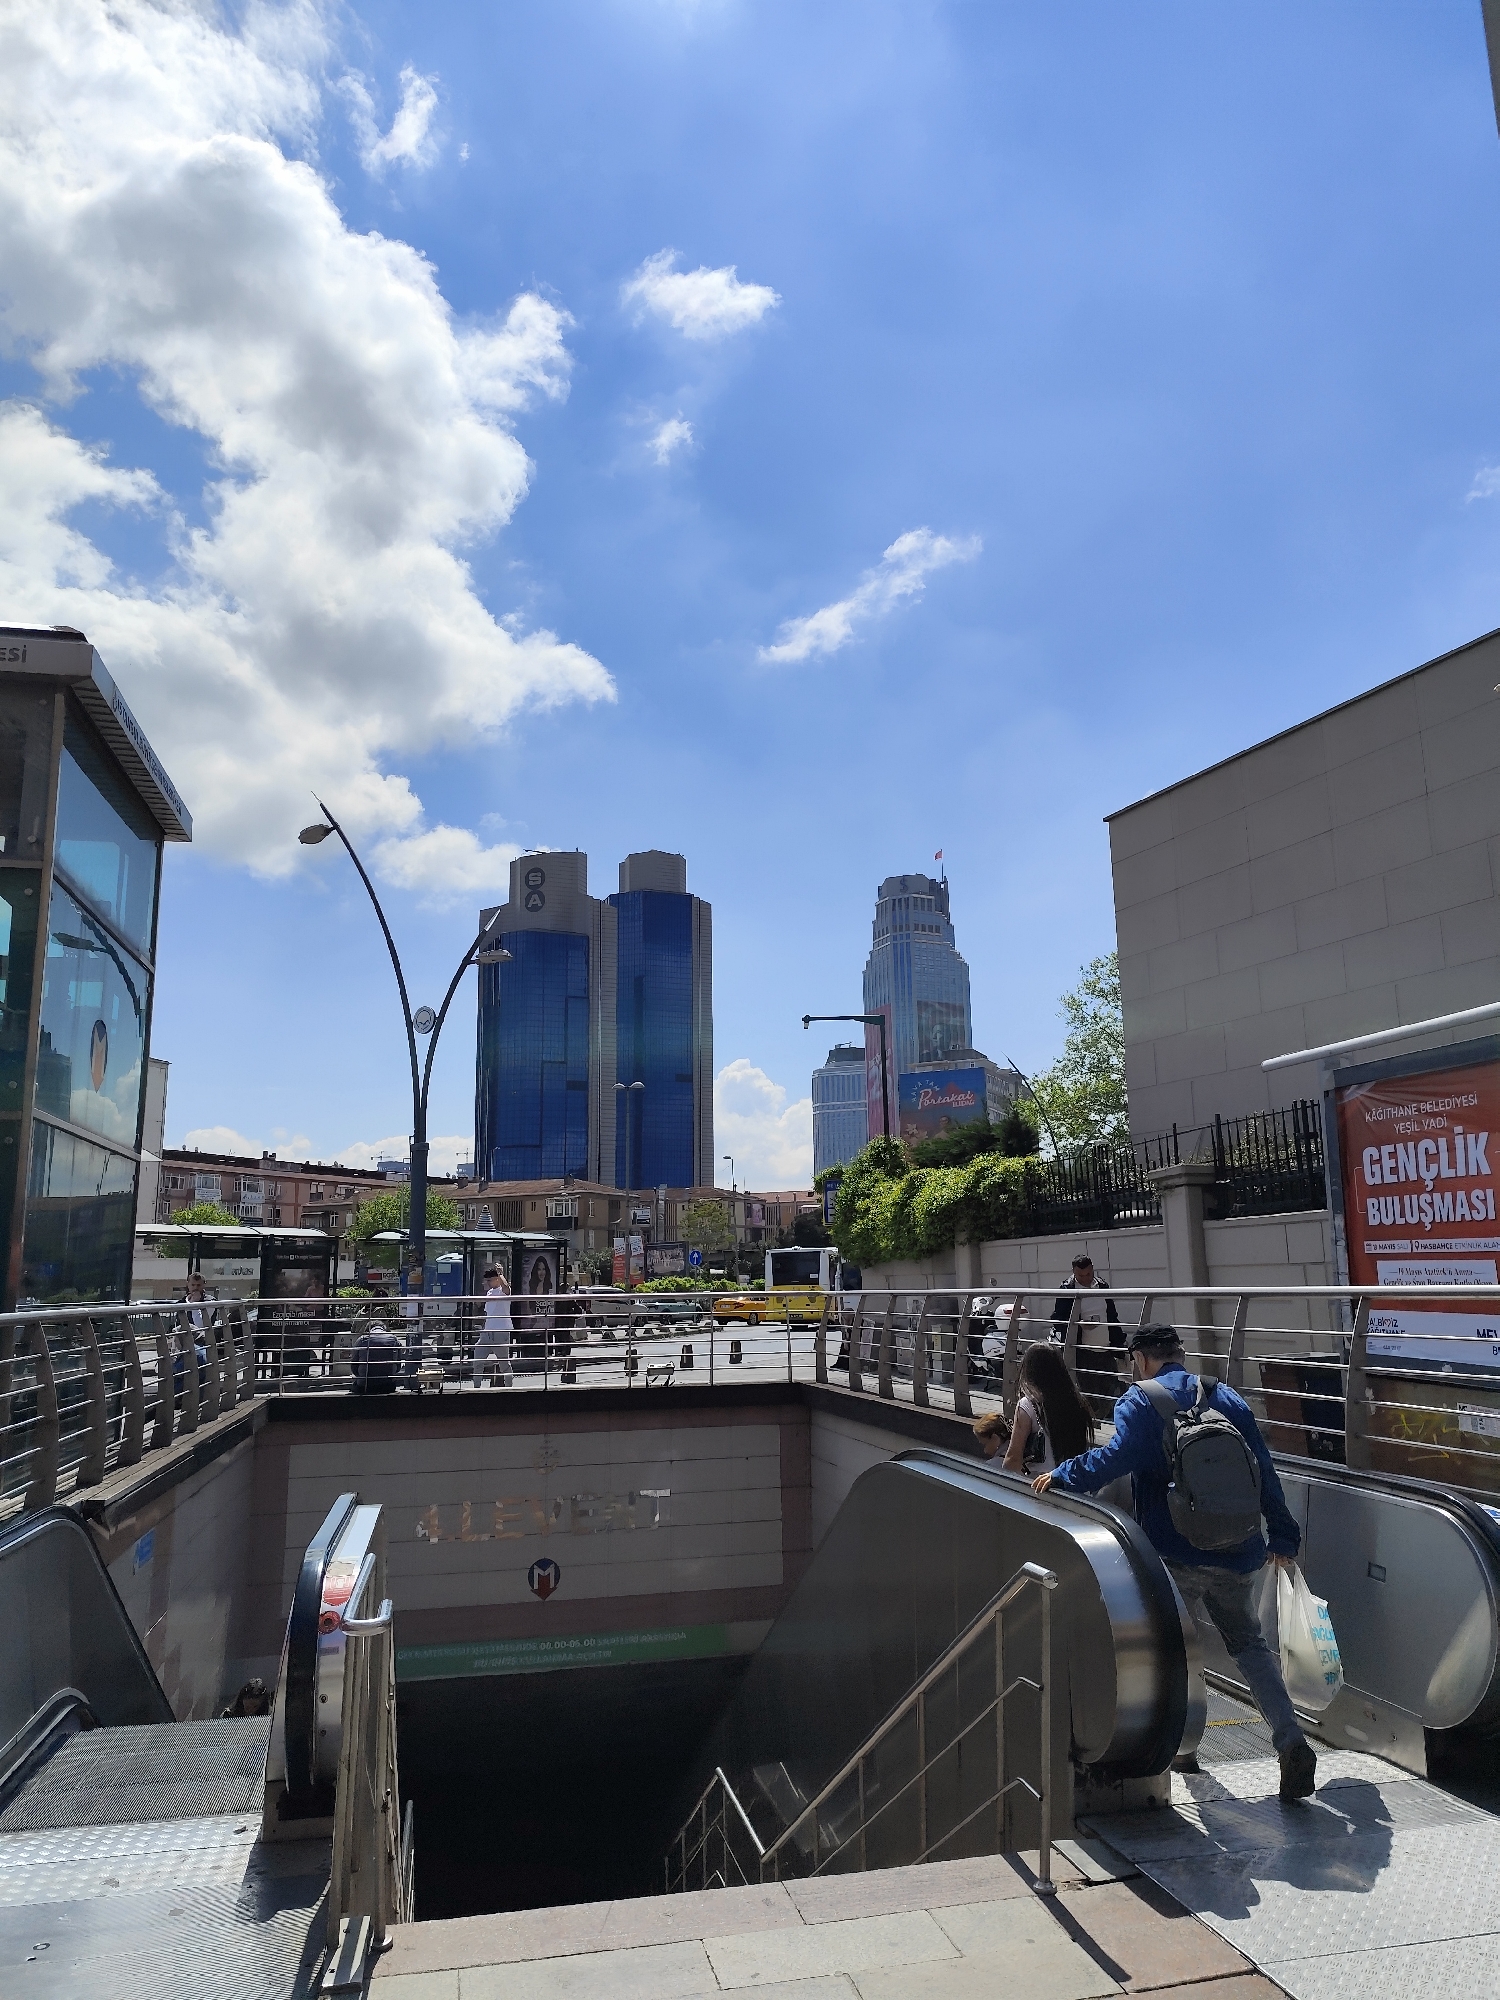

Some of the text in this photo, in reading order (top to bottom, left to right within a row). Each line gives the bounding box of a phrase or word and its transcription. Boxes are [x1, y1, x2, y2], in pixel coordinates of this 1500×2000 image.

[1420, 1091, 1478, 1114] BELEDİYESİ
[1394, 1114, 1447, 1135] YEŞİL VADİ
[1363, 1126, 1492, 1192] GENÇLİK
[1366, 1189, 1496, 1232] BULUŞMASI
[1378, 1243, 1396, 1251] MAYIS
